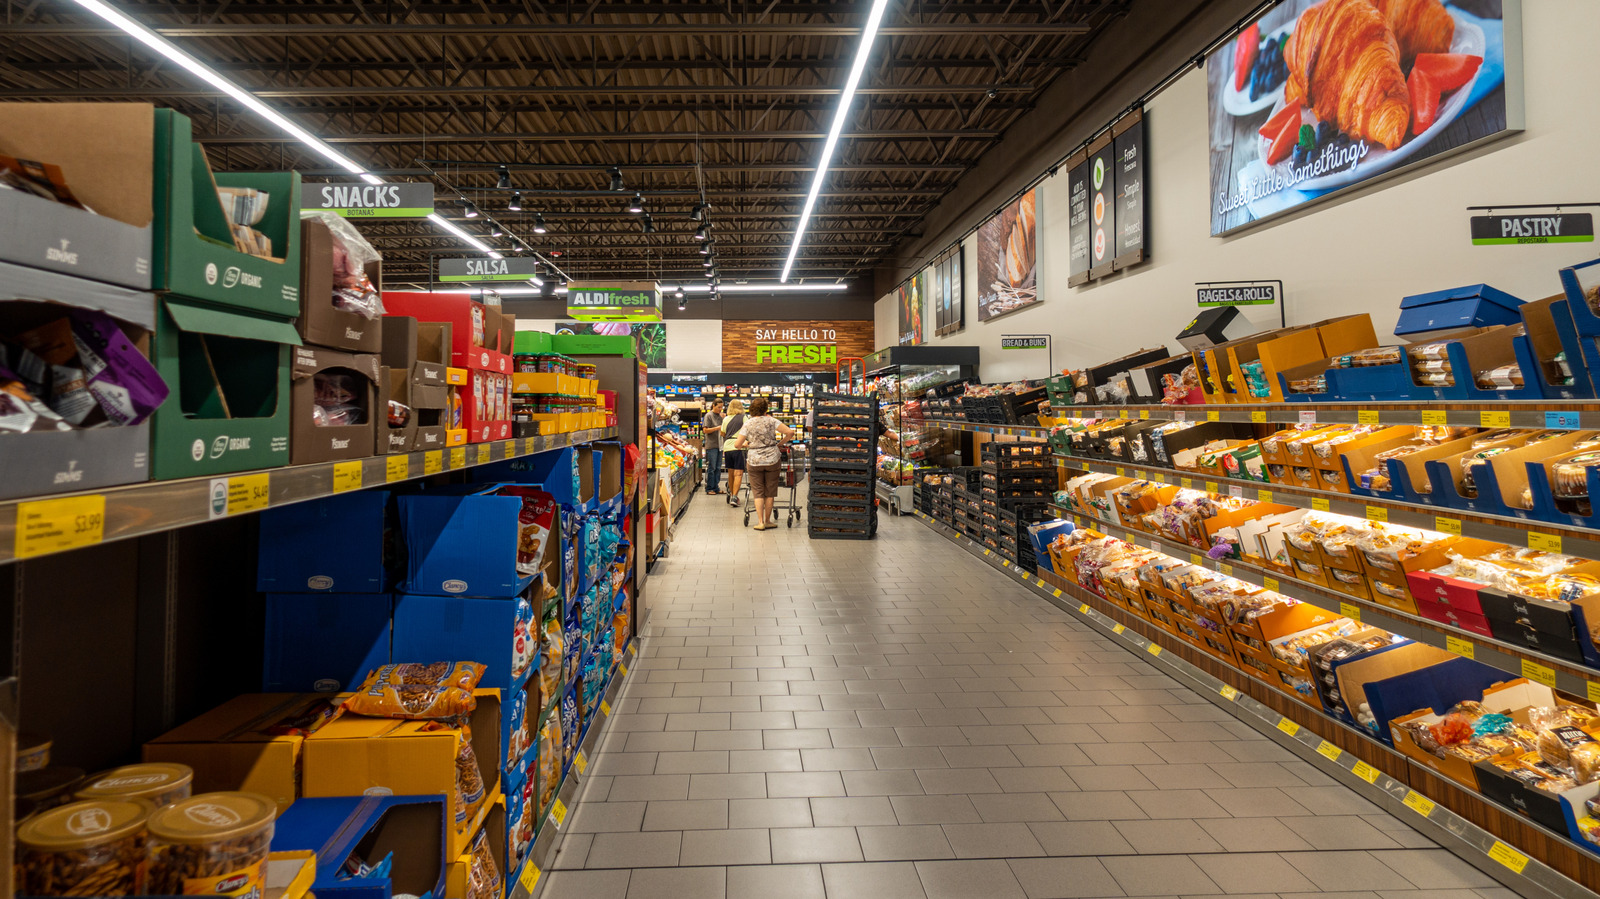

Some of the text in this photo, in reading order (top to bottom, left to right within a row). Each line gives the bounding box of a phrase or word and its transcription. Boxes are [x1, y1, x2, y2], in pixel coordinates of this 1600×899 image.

[1124, 144, 1137, 162] Fresh
[1218, 139, 1370, 215] Sweet Little Somethings
[321, 186, 400, 208] SNACKS
[1124, 179, 1140, 198] Simple
[1125, 219, 1141, 236] Honest
[1501, 217, 1562, 237] PASTRY
[466, 259, 509, 275] SALSA
[240, 272, 262, 289] ORGANIC
[756, 329, 836, 340] SAY HELLO TO
[1002, 339, 1023, 347] BREAD
[756, 345, 837, 364] FRESH
[229, 437, 251, 450] ORGANIC
[215, 490, 224, 498] USDA
[74, 513, 101, 533] $3.99
[1548, 540, 1560, 548] $3.99
[215, 874, 249, 893] Clancy's
